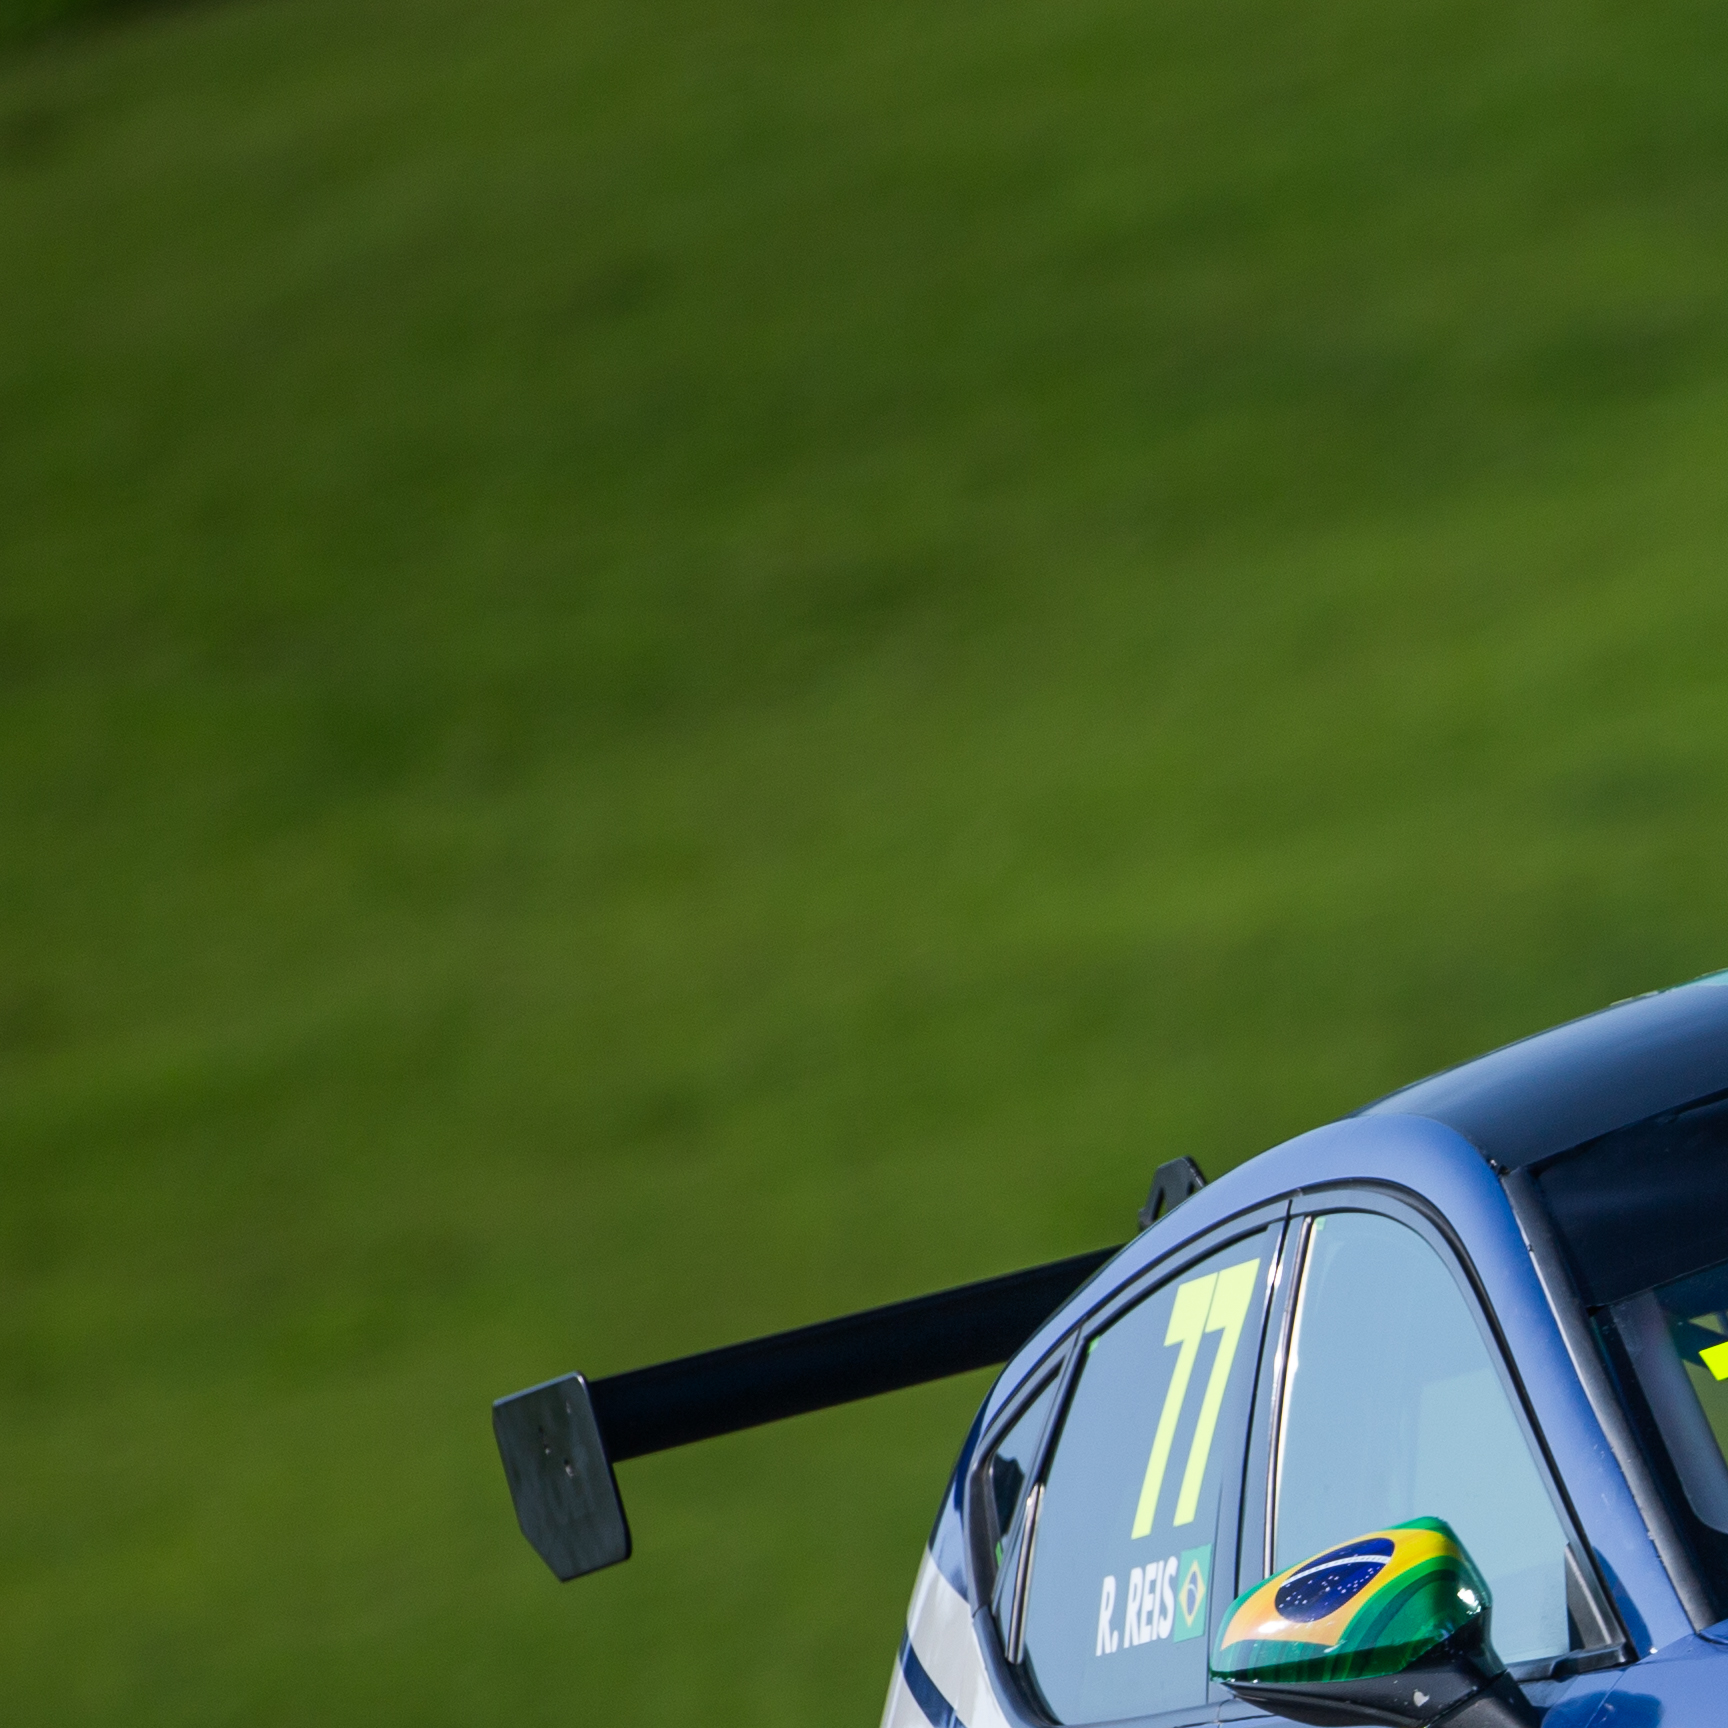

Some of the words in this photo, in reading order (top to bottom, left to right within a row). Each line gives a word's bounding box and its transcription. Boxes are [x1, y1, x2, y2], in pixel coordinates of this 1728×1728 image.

[1131, 1257, 1261, 1540] 77
[1095, 1574, 1119, 1657] R.
[1123, 1555, 1179, 1649] REIS
